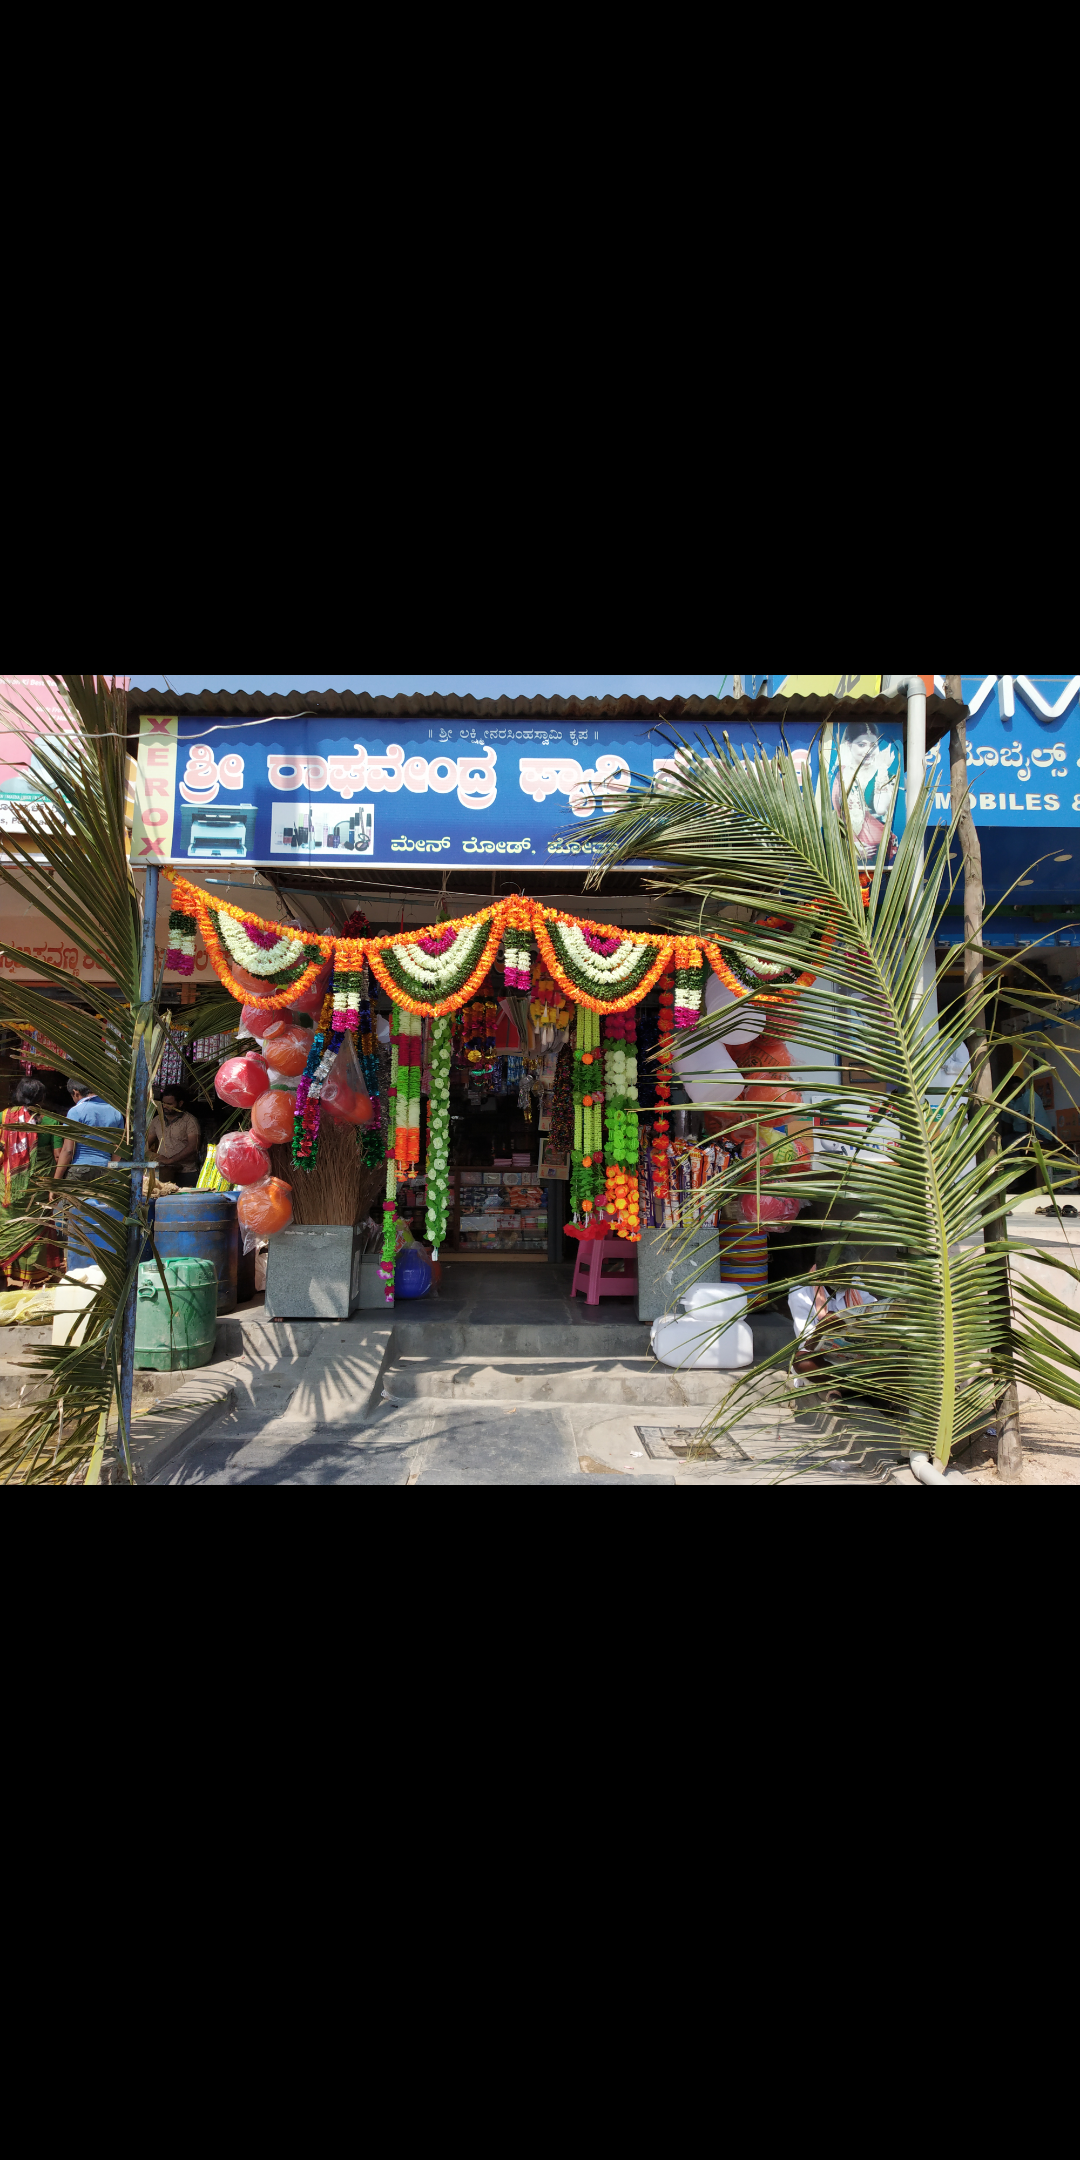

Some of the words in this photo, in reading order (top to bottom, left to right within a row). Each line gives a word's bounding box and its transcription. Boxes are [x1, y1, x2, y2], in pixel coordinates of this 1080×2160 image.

[438, 728, 453, 743] ಶ್ರೀ
[138, 718, 172, 856] XEROX
[178, 743, 245, 804] ಶ್ರೀ
[266, 743, 498, 810] ರಾಘವೇಂದ್ರ
[390, 835, 451, 853] ಮೇನ್
[462, 836, 536, 855] ರೋಡ್,
